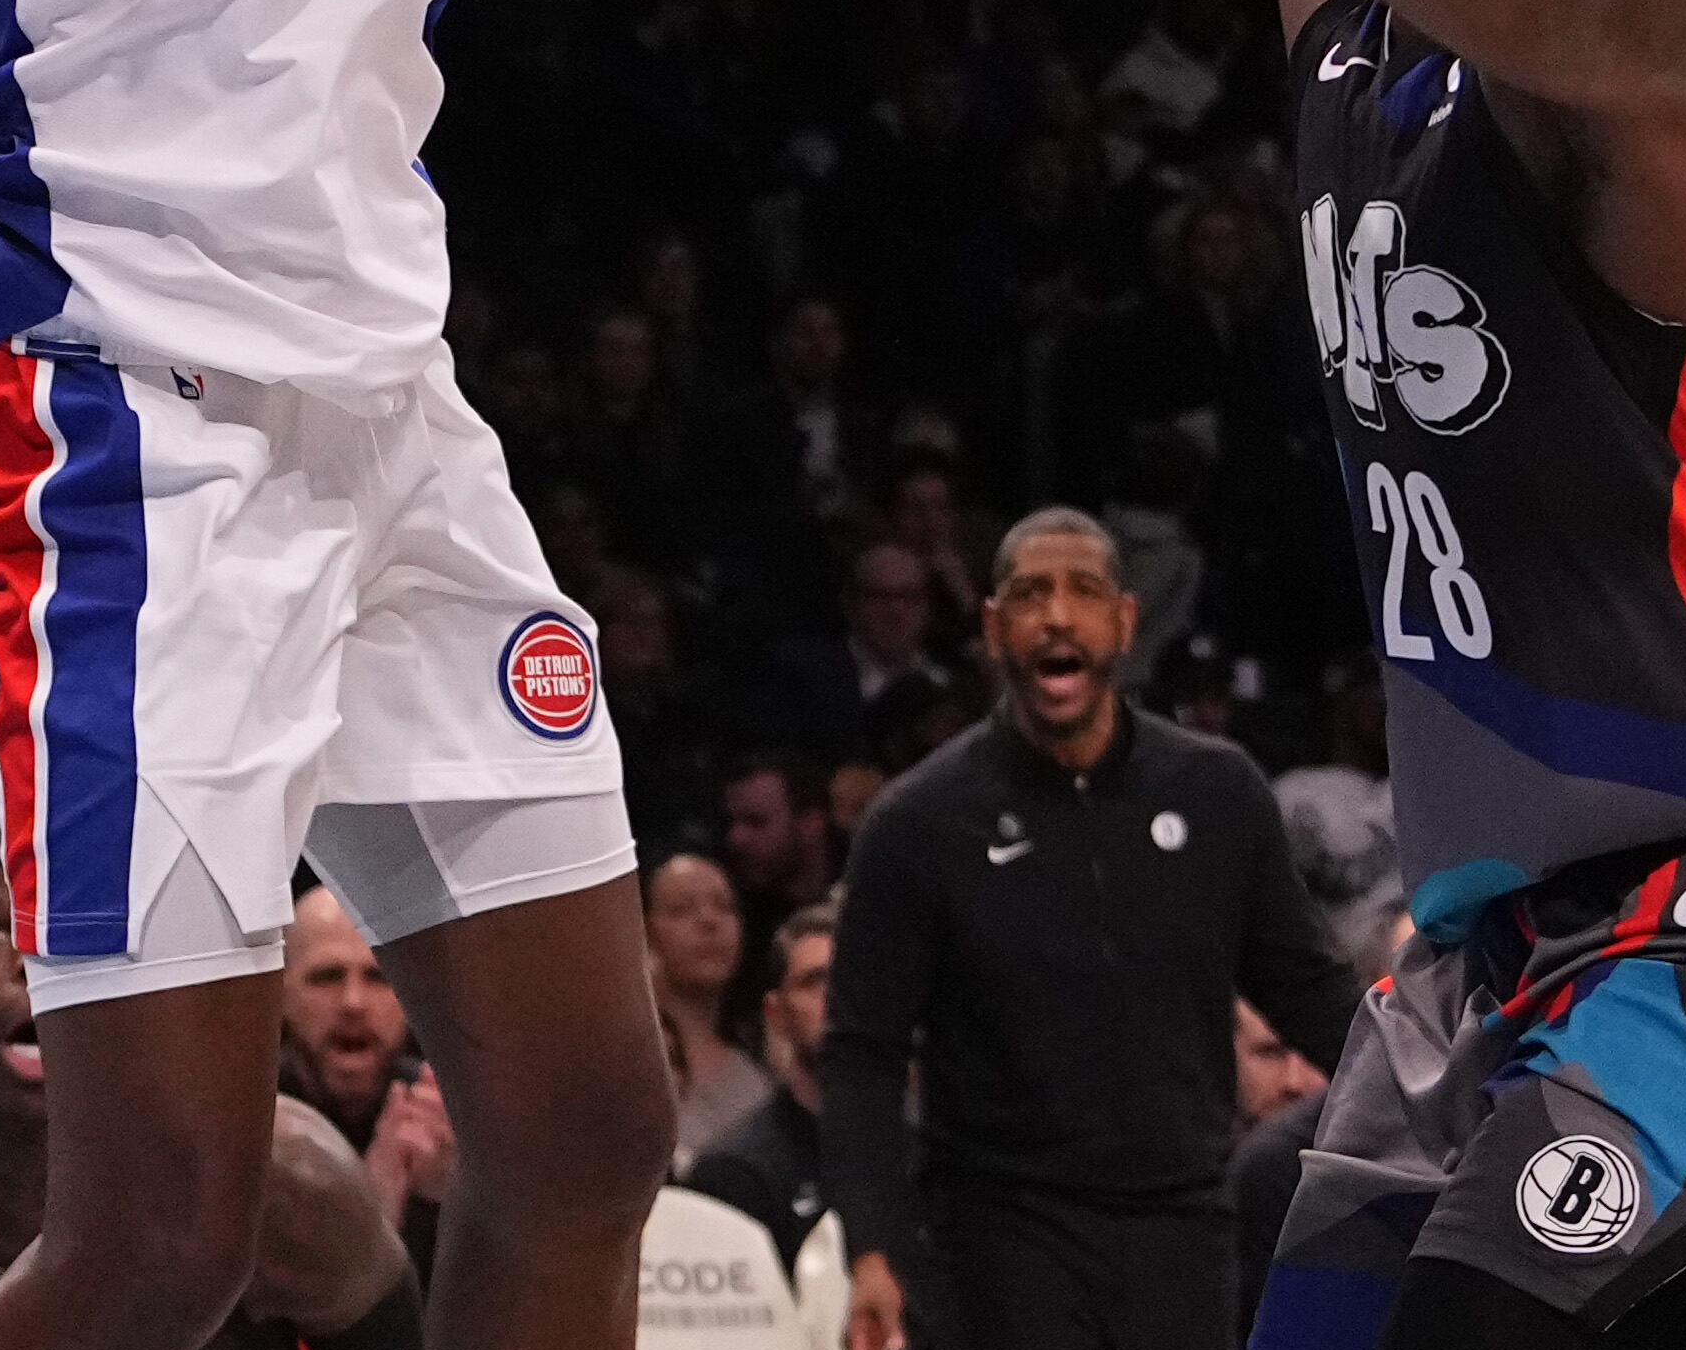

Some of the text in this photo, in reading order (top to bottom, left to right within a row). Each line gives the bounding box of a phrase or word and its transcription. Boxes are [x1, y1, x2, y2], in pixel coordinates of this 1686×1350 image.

[1366, 461, 1492, 661] 28
[523, 655, 583, 676] DETROIT
[523, 676, 586, 697] PISTONS
[1547, 1152, 1610, 1229] B
